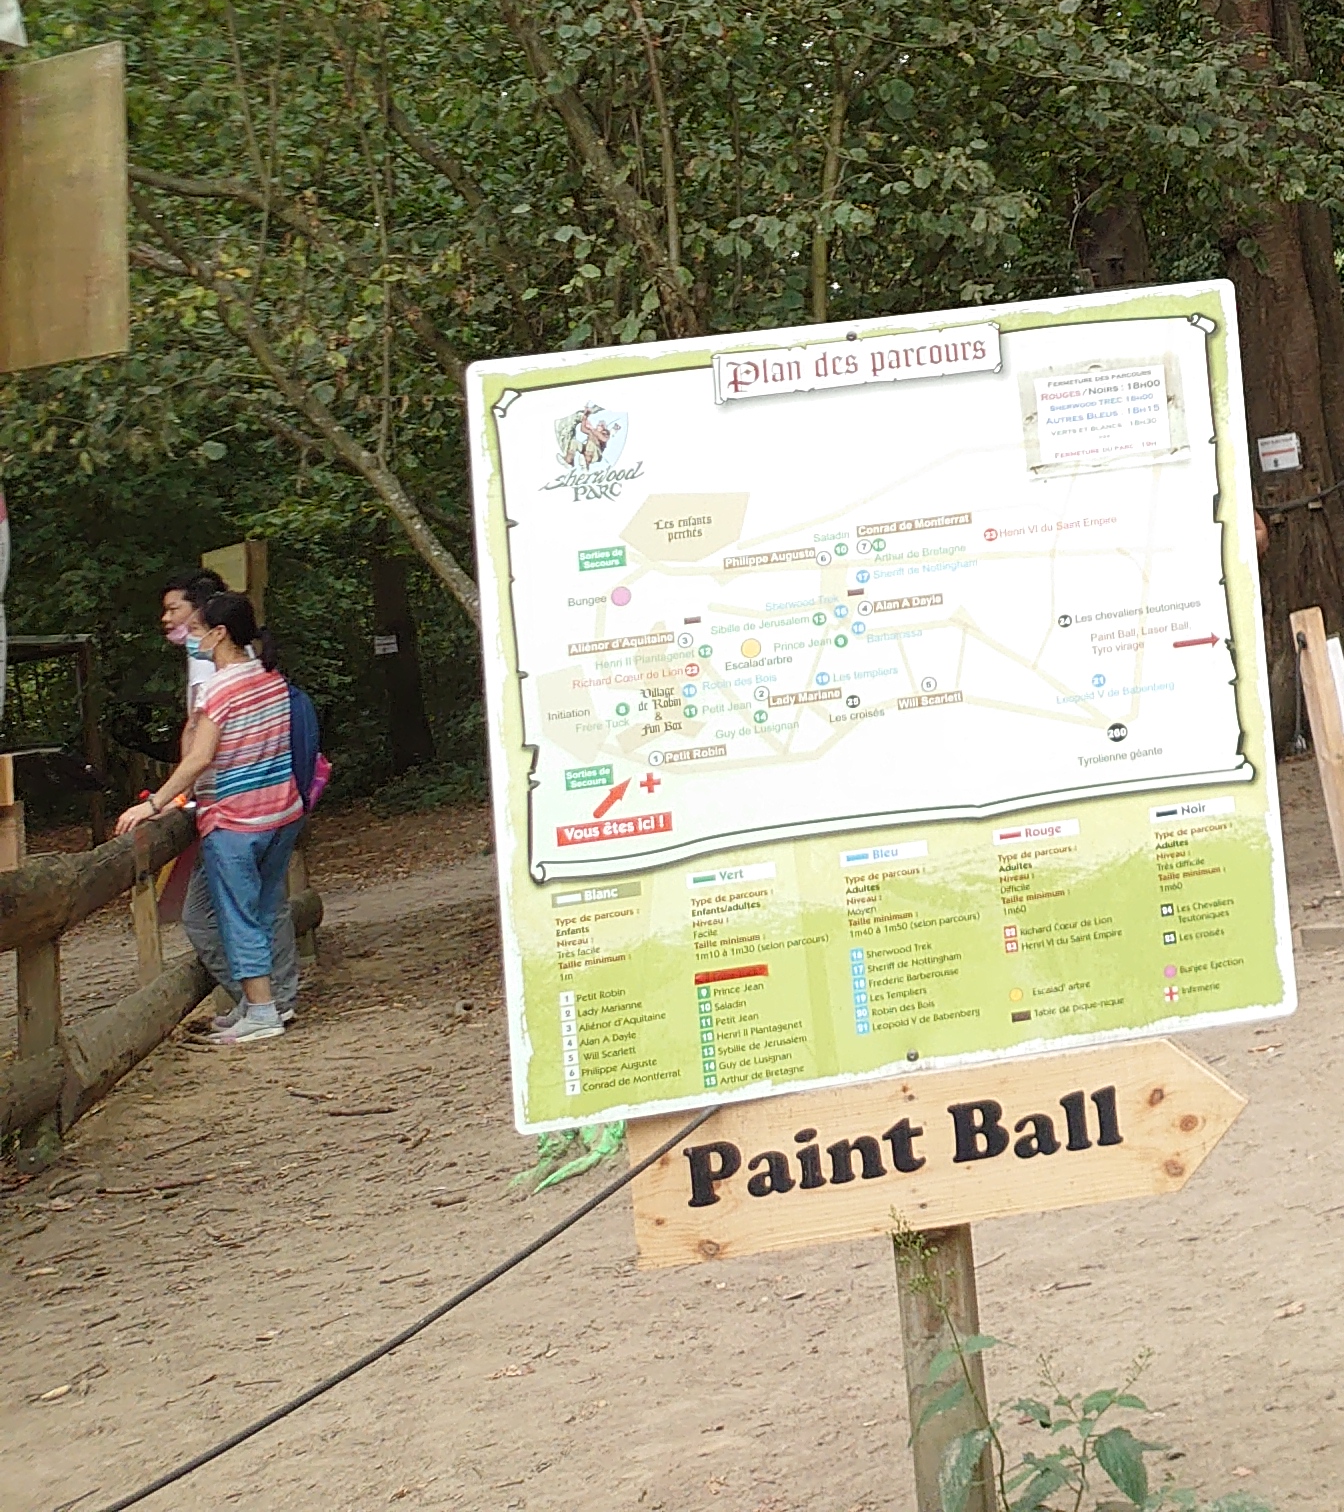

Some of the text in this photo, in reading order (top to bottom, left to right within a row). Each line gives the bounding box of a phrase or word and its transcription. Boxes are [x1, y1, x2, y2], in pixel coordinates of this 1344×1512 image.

[726, 340, 986, 393] Plan des parcours
[1048, 378, 1092, 388] FERMETURE
[1112, 370, 1151, 380] PARCOURS
[1128, 380, 1161, 390] 18H00
[1050, 393, 1153, 411] SHERWOOD TREC 18H00
[1046, 404, 1160, 425] AUTRES BLEUS 18H15
[1055, 449, 1099, 458] FERMETURE
[654, 515, 712, 530] Les enfants
[858, 515, 969, 536] Conrad de Montferrat
[1000, 516, 1117, 538] Henri VI du Saint Empire
[813, 531, 849, 543] Saladin
[579, 549, 623, 560] Sorties de
[725, 549, 814, 568] Philippe Auguste
[584, 558, 619, 569] Secours
[568, 595, 607, 607] Bungee
[875, 600, 899, 612] Alan
[901, 598, 912, 607] A
[1075, 600, 1201, 623] Les chevaliers teutoniques
[711, 617, 809, 635] Sibille de Jerusalem
[1091, 631, 1115, 641] Paint
[1142, 625, 1168, 635] Laser
[570, 633, 673, 654] Aliénor d'Aquitaine
[774, 637, 831, 652] Prince Jean
[1092, 642, 1145, 656] Tyro virage
[596, 657, 622, 670] Henri
[636, 650, 695, 664] Plantagenet
[725, 655, 792, 671] Escalad'arbre
[573, 675, 612, 688] Richard
[662, 668, 683, 677] Lion
[640, 687, 674, 698] Village
[639, 697, 681, 712] de Robin
[702, 701, 751, 714] Petit Jean
[769, 695, 795, 706] Lady
[898, 692, 962, 709] Will Scarlett
[548, 709, 590, 721] Initiation
[655, 712, 662, 721] &
[830, 709, 885, 723] Les croisés
[607, 718, 630, 729] Tuck
[642, 721, 683, 737] Fun Box
[716, 721, 799, 739] Guy de Lusignan
[1108, 728, 1127, 738] 260
[665, 746, 725, 763] Petit Robin
[1078, 747, 1163, 767] Tyrolienne géante
[566, 767, 610, 779] Sorties de
[570, 777, 606, 788] Secours
[1181, 803, 1206, 815] Noir
[565, 825, 599, 840] Vous
[603, 821, 634, 834] êtes
[638, 817, 654, 831] ici
[1025, 826, 1061, 838] Rouge
[873, 848, 898, 860] Bleu
[719, 869, 744, 881] Vert
[584, 887, 618, 901] Blanc
[692, 901, 761, 917] Enfants/adultes
[556, 925, 589, 937] Enfants
[866, 942, 932, 958] Sherwood Trek
[576, 988, 625, 1002] Petit Robin
[714, 982, 764, 997] Prince Jean
[578, 1001, 642, 1018] Lady Marianne
[716, 1013, 759, 1026] Petit Jean
[583, 1046, 636, 1061] Will Scarlett
[719, 1052, 792, 1070] Guy de Lusignan
[582, 1069, 681, 1092] Conrad de Montferrat
[720, 1065, 804, 1085] Arthur de Bretagne
[683, 1086, 1124, 1207] Paint Ball
